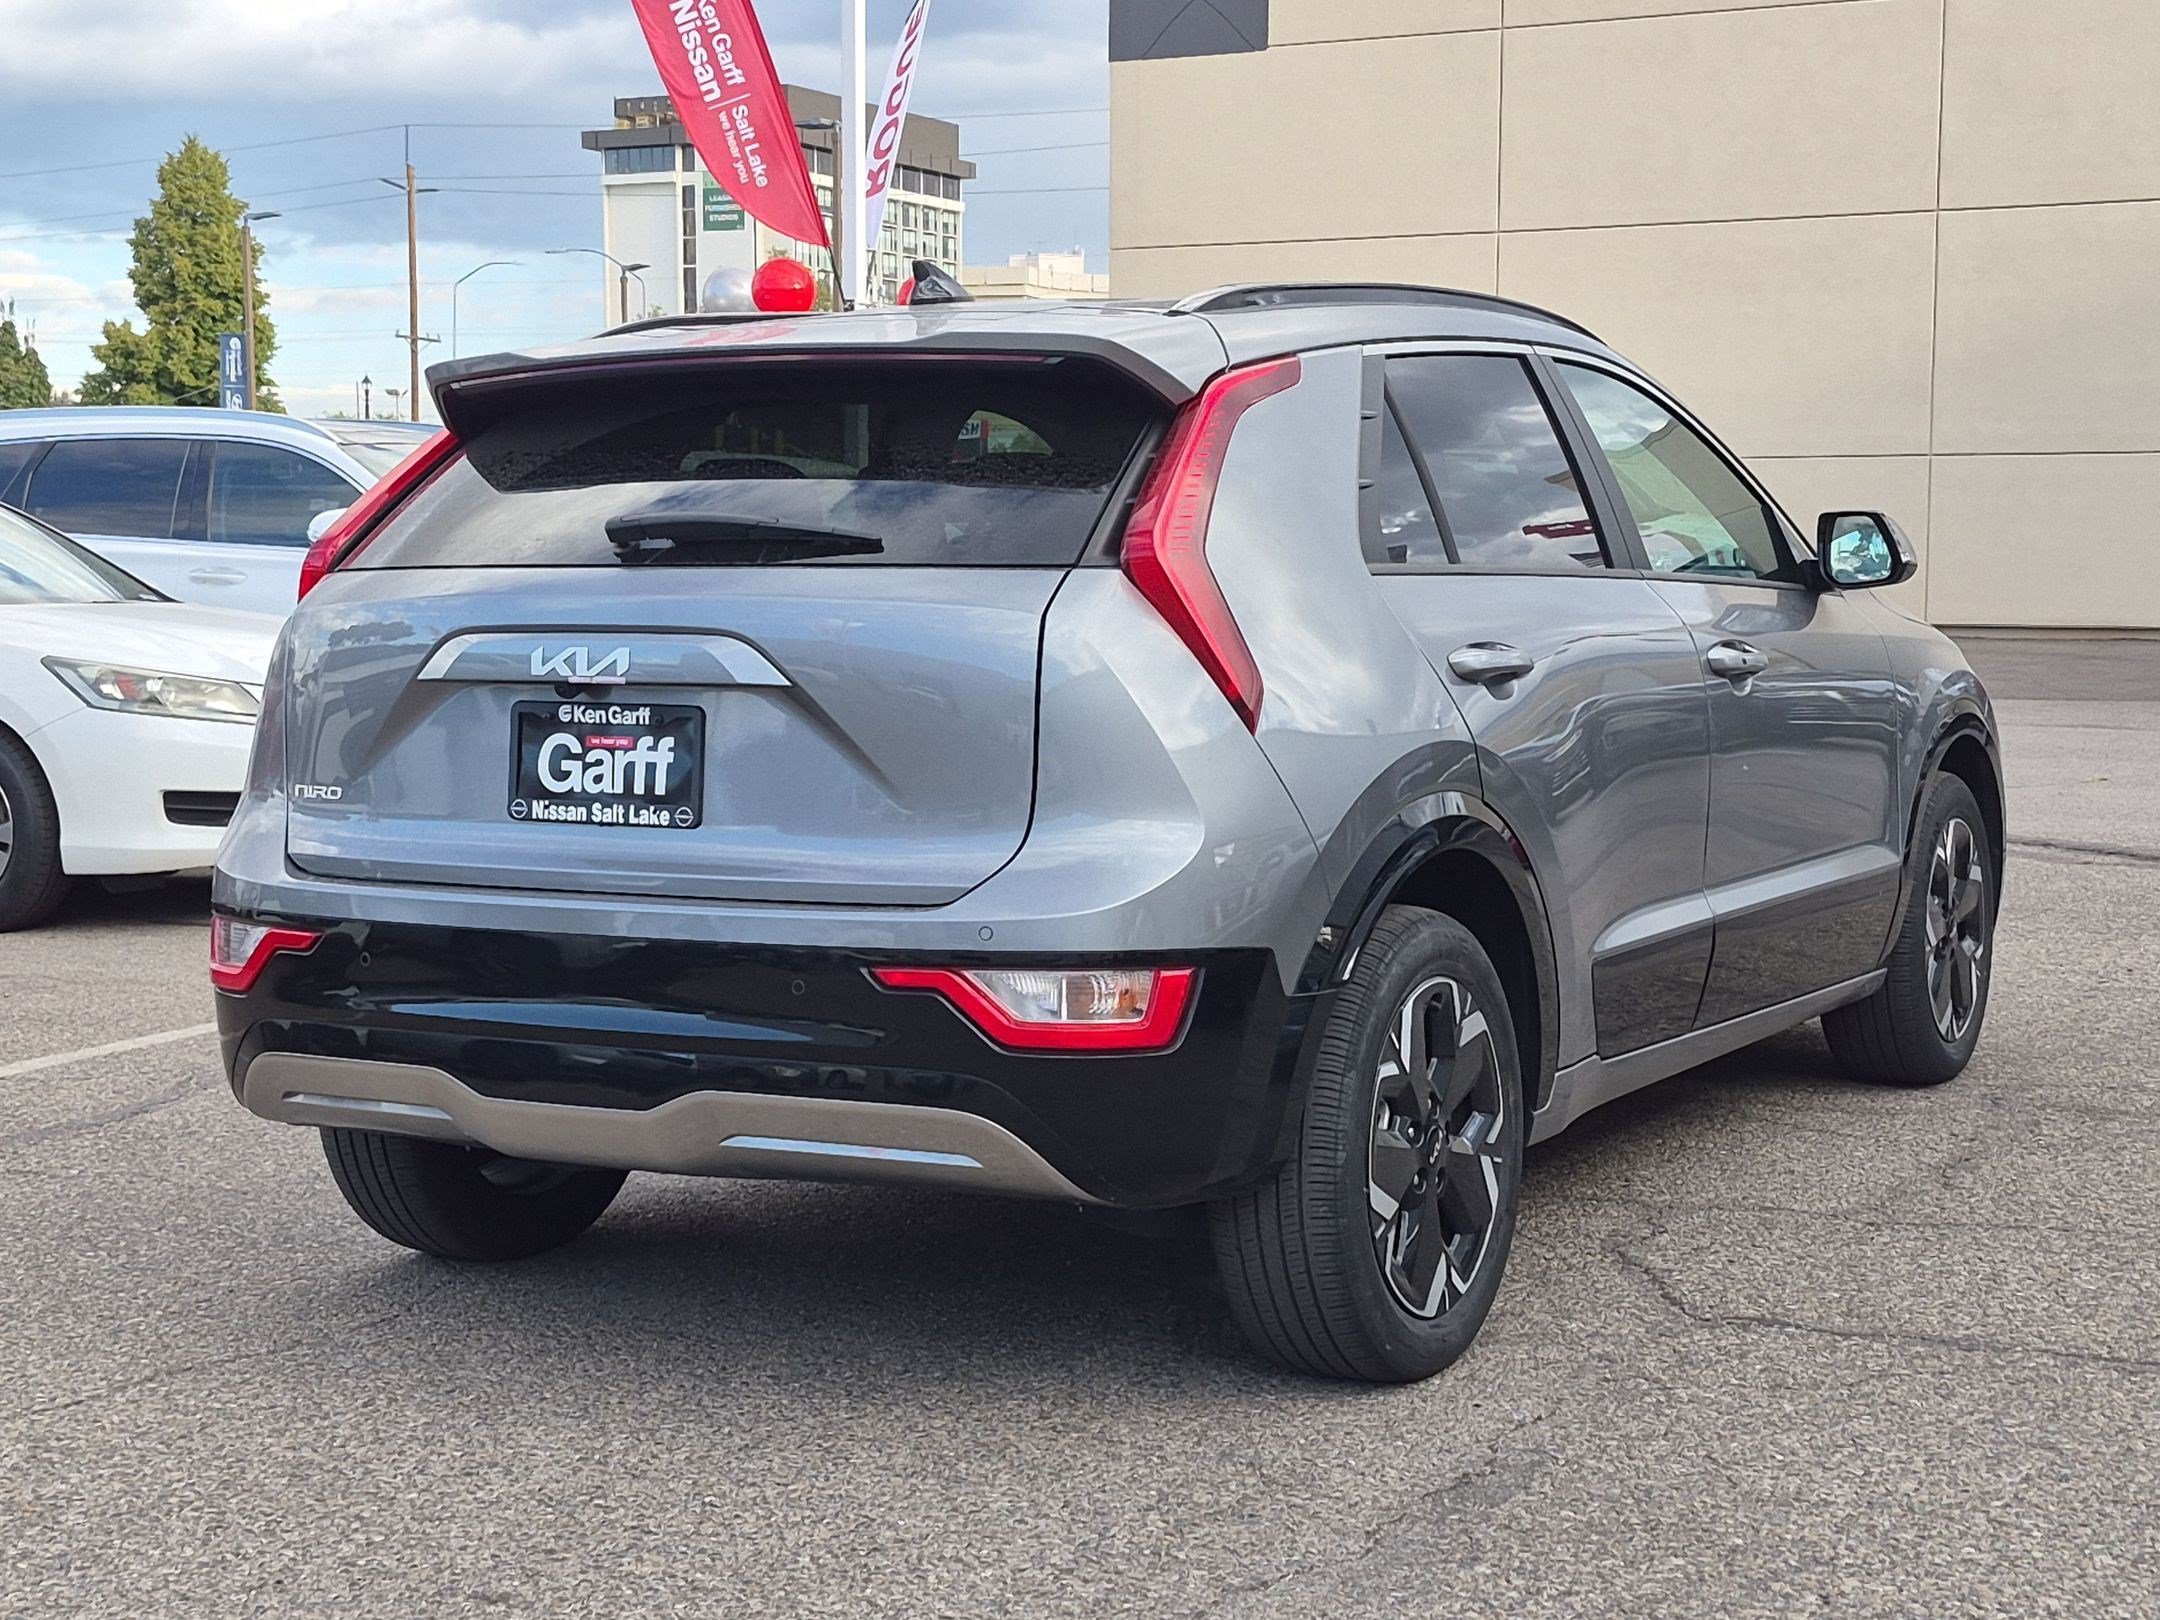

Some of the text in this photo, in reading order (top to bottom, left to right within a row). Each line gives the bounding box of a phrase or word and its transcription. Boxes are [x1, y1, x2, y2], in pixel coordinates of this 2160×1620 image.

[668, 1, 722, 103] Nissan
[711, 33, 746, 86] Garff
[718, 111, 749, 184] we hear you
[731, 104, 769, 188] Salt Lake
[530, 645, 631, 678] KIA
[573, 704, 651, 726] Ken Garff
[537, 732, 675, 797] Garff
[294, 783, 343, 800] NIRO
[531, 799, 671, 827] Nissan Salt Lake
